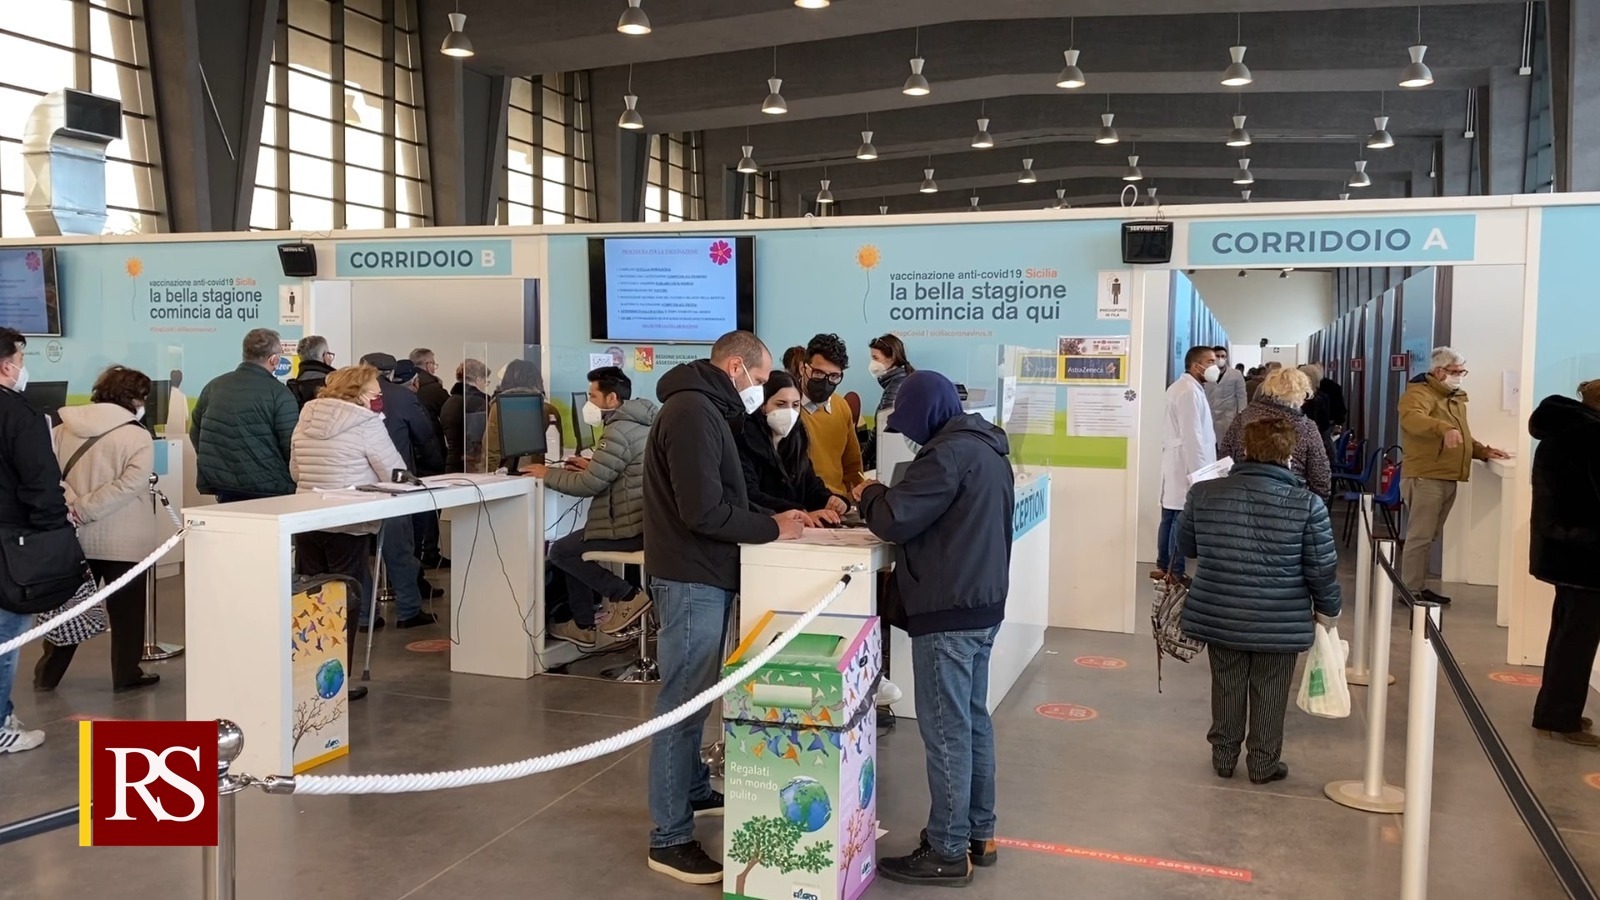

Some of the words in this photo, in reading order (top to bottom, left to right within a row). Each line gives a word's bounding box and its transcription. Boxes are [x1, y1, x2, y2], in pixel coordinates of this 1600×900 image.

[1212, 228, 1411, 254] CORRIDOIO
[1422, 228, 1448, 250] A
[350, 250, 473, 269] CORRIDOIO
[481, 250, 496, 267] B
[193, 278, 234, 286] anti-covid19
[235, 278, 256, 286] Sicilia
[890, 271, 955, 281] vaccinazione
[958, 269, 1022, 280] anti-covid19
[1025, 268, 1058, 279] Sicilia
[150, 288, 161, 302] la
[166, 288, 198, 302] bella
[202, 287, 262, 305] stagione
[890, 282, 907, 300] la
[915, 282, 964, 300] bella
[972, 281, 1067, 303] stagione
[150, 304, 211, 318] comincia
[216, 304, 233, 318] da
[237, 304, 259, 321] qui
[889, 302, 984, 320] comincia
[991, 302, 1018, 320] da
[1026, 301, 1060, 323] qui
[1014, 488, 1045, 532] CEPTION
[730, 761, 770, 777] Regalati
[745, 780, 778, 791] mondo
[730, 790, 757, 801] pulito
[1064, 848, 1120, 860] ASPETTA
[1157, 861, 1215, 873] ASPETTA
[1218, 869, 1243, 877] QUI
